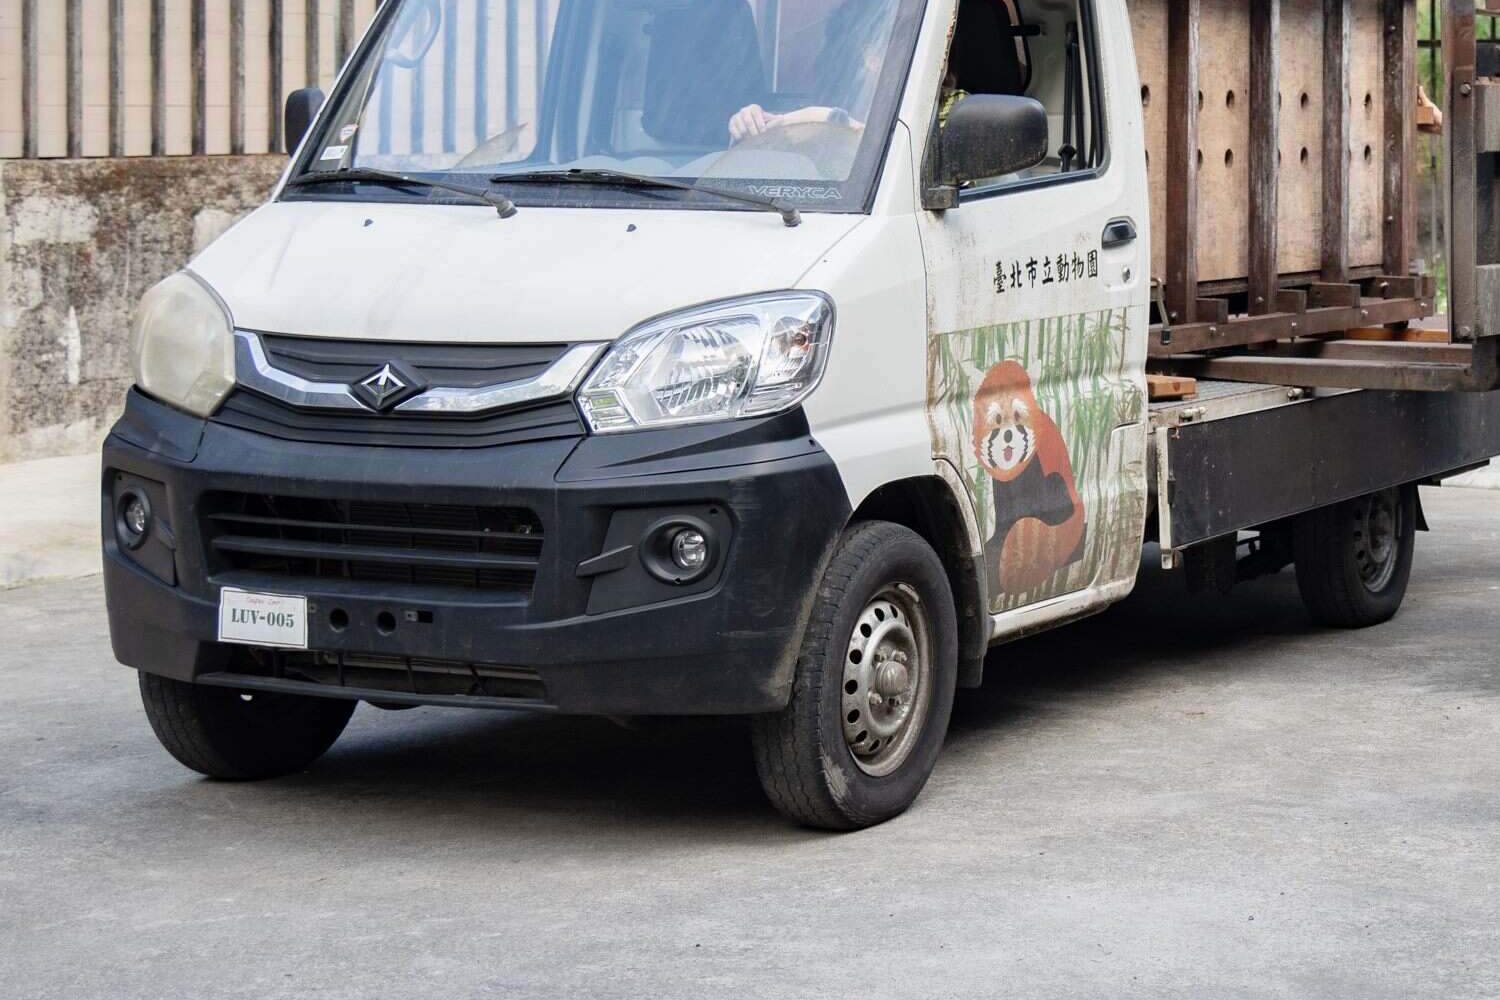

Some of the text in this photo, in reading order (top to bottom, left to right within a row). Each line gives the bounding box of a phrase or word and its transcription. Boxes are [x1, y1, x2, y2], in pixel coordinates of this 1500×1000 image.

[747, 184, 842, 200] VERYCA
[993, 249, 1098, 294] 臺北市立動物園
[231, 607, 295, 629] LUV-005
